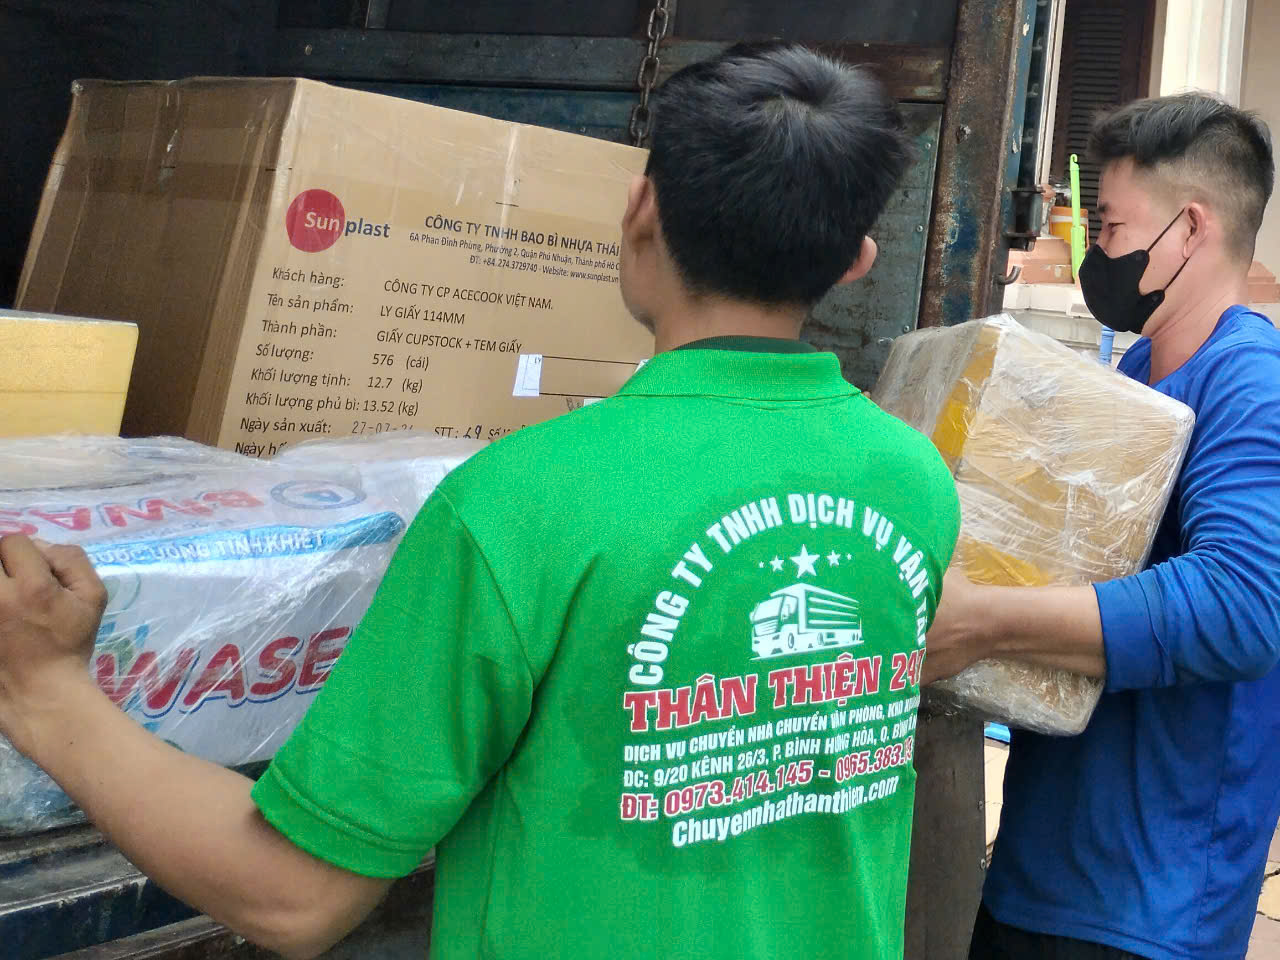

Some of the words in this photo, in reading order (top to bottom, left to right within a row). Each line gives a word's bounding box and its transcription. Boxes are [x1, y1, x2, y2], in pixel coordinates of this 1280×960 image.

[425, 214, 462, 232] CÔNG
[466, 222, 481, 236] TY
[484, 225, 518, 241] TNHH
[521, 231, 544, 245] BAO
[547, 232, 558, 247] BÌ
[561, 237, 593, 253] NHỰA
[596, 242, 620, 257] THÁI
[272, 267, 306, 283] Khách
[310, 271, 345, 289] hàng:
[267, 293, 284, 307] Tên
[288, 295, 310, 310] sản
[313, 298, 354, 314] phẩm:
[384, 279, 417, 294] CÔNG
[421, 284, 434, 297] TY
[437, 286, 450, 298] CP
[452, 289, 503, 305] ACECOOK
[506, 293, 527, 308] VIỆT
[381, 305, 392, 317] LY
[395, 304, 421, 320] GIẤY
[423, 310, 465, 325] 114MM
[262, 320, 297, 335] Thành
[300, 323, 337, 338] phần:
[377, 328, 403, 343] GIẤY
[406, 332, 462, 349] CUPSTOCK
[474, 339, 496, 352] TEM
[499, 339, 522, 354] GIẤY
[256, 343, 270, 357] Số
[271, 345, 314, 362] lượng:
[372, 353, 394, 366] 576
[406, 355, 429, 371] (cái)
[251, 367, 276, 382] Khối
[280, 369, 318, 387] lượng
[367, 376, 393, 389] 12.7
[402, 378, 423, 394] (kg)
[245, 392, 271, 406] Khối
[275, 394, 313, 411] lượng
[317, 396, 342, 412] phủ
[345, 398, 360, 411] bì:
[363, 400, 395, 413] 13.52
[398, 401, 419, 417] (kg)
[240, 417, 270, 433] Ngày
[273, 417, 296, 432] sản
[299, 419, 331, 433] xuất:
[627, 590, 690, 685] CÔNG
[671, 542, 713, 588] TY
[706, 497, 783, 553] TNHH
[788, 493, 854, 529] DỊCH
[862, 506, 894, 551] VỤ
[893, 535, 928, 599] VẬN
[624, 673, 757, 732] THÂN
[768, 652, 882, 710] THIỆN
[624, 744, 661, 765] DỊCH
[666, 741, 686, 761] VỤ
[689, 724, 744, 754] CHUYỂN
[748, 721, 773, 743] NHÀ
[776, 711, 827, 736] CHUYỂN
[849, 704, 885, 725] PHÒNG,
[623, 770, 649, 788] ĐC:
[654, 764, 687, 786] 9/20
[691, 755, 733, 779] KÊNH
[737, 748, 769, 771] 26/3,
[785, 736, 821, 758] BÌNH
[852, 725, 877, 748] HÒA,
[620, 793, 658, 821] ĐT:
[664, 760, 814, 817] 0973.414.145
[672, 776, 899, 848] Chuyennhathanthien.com
